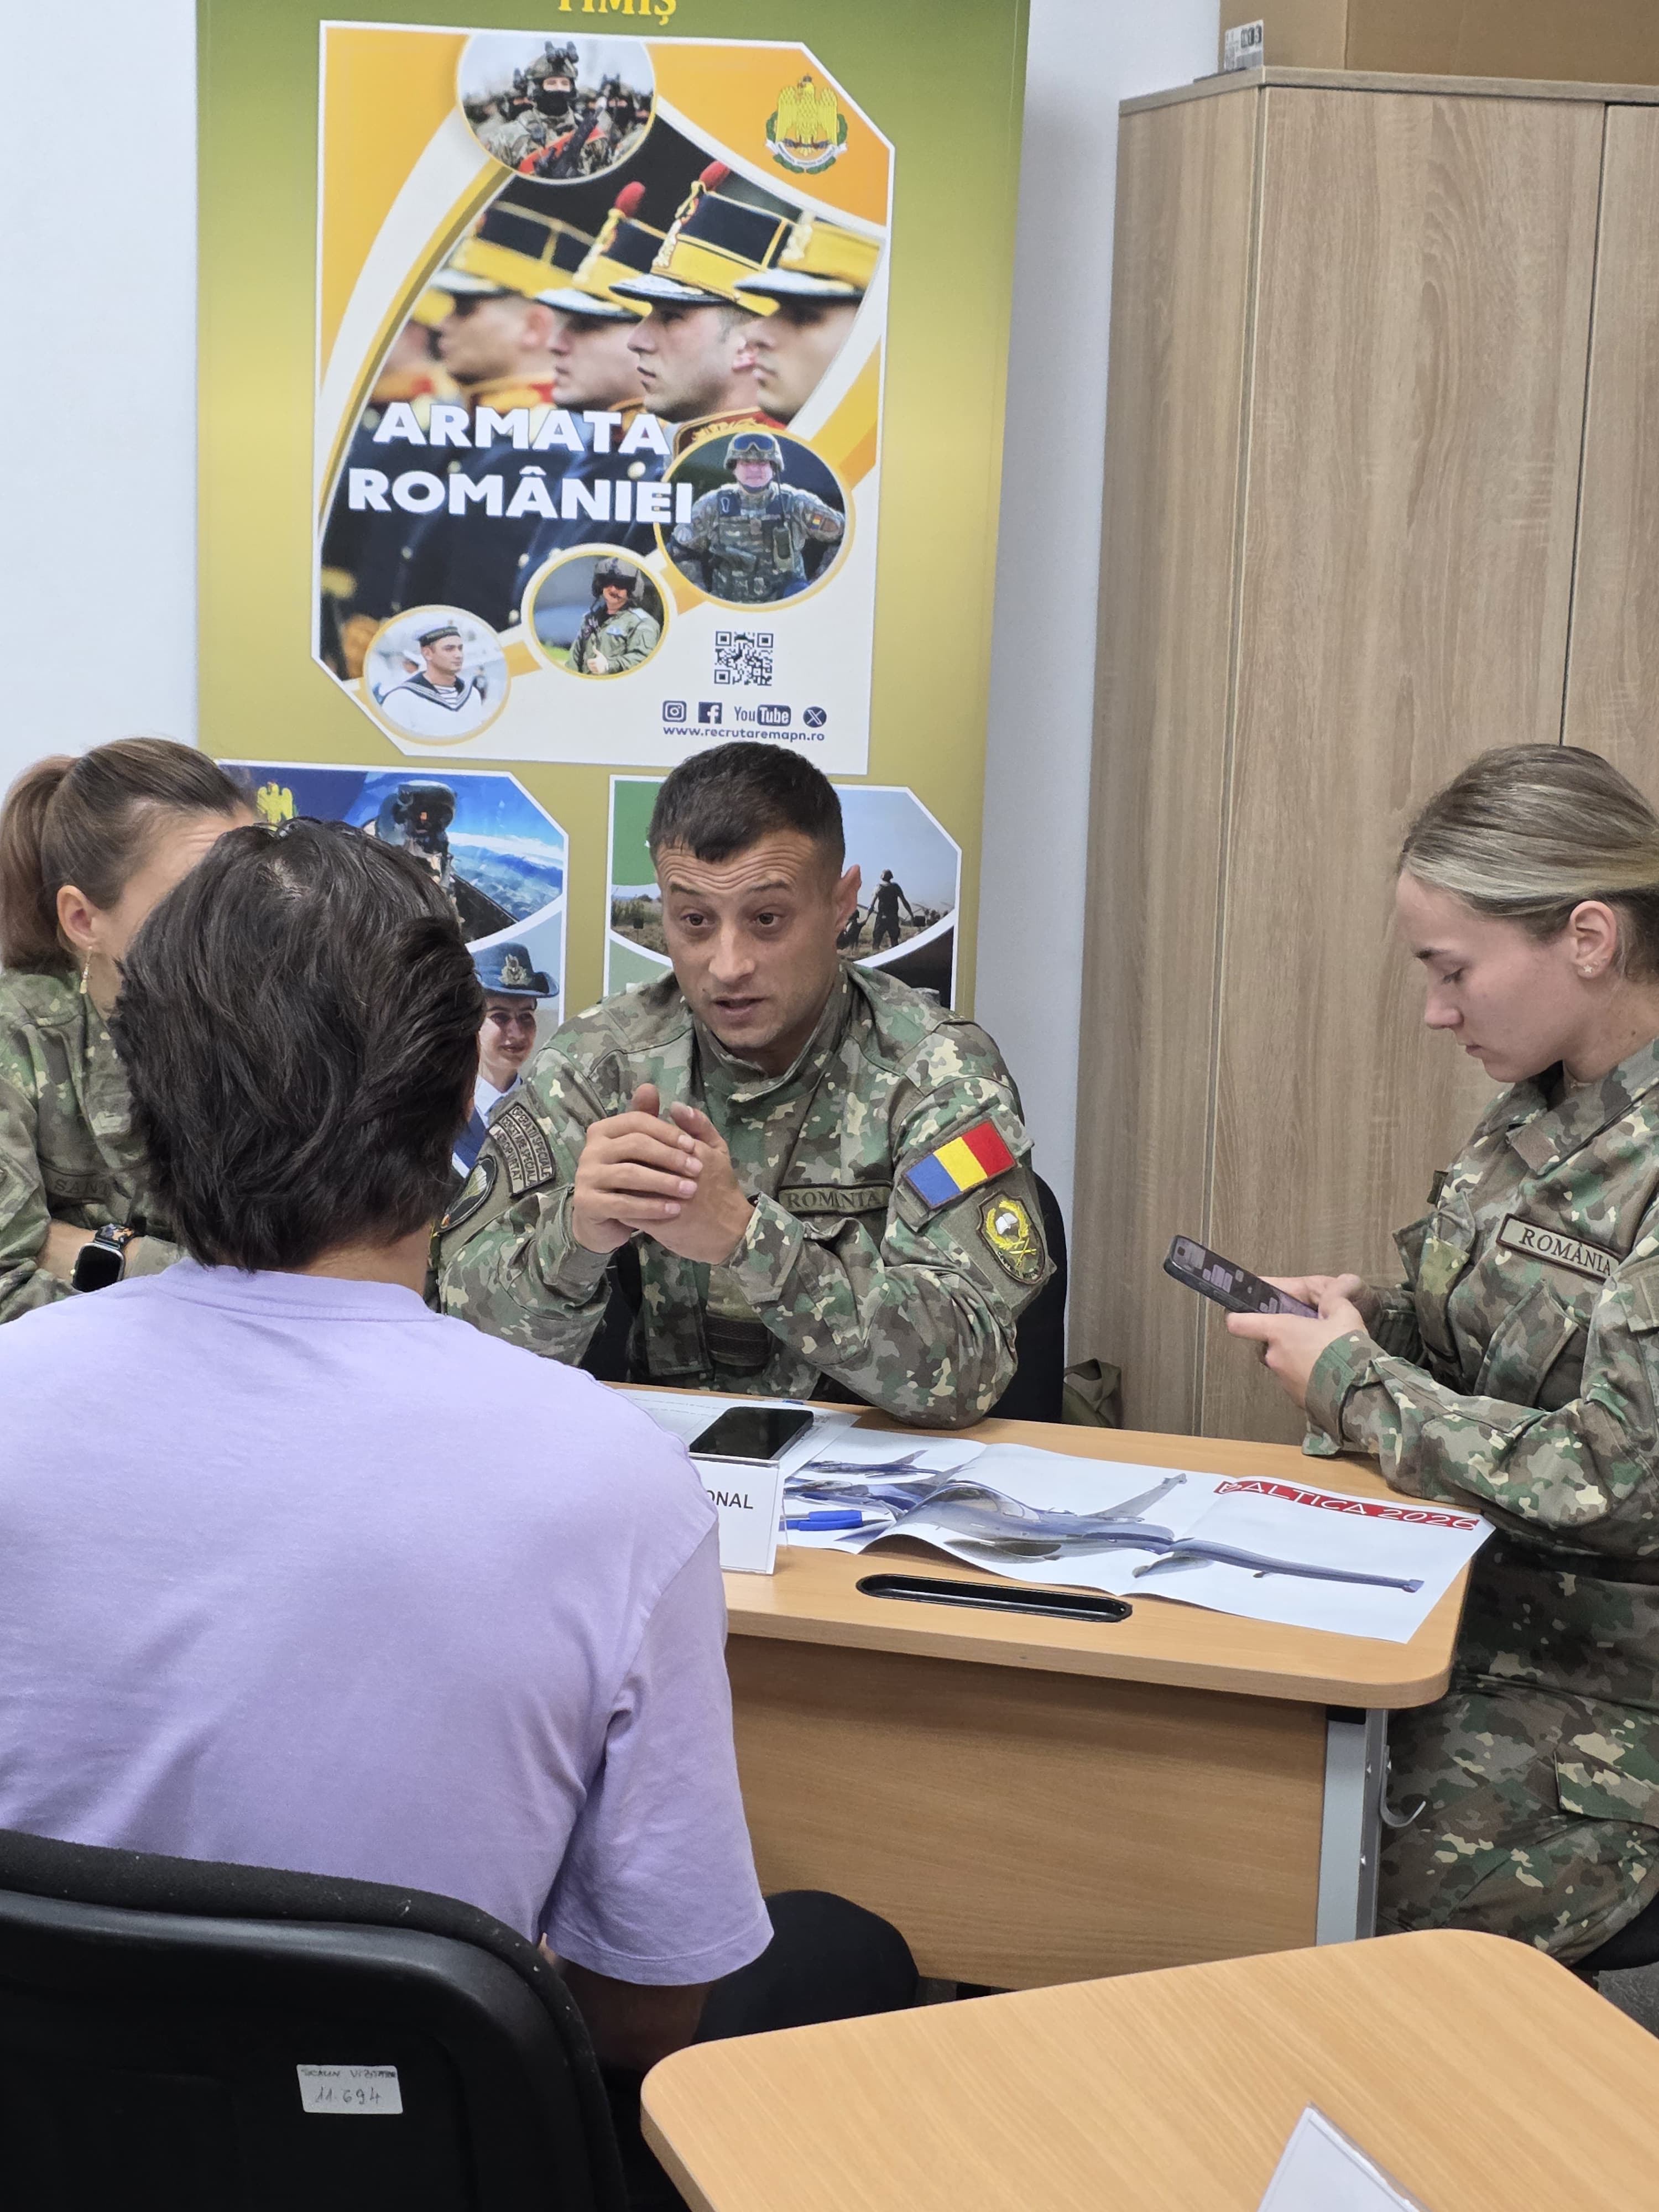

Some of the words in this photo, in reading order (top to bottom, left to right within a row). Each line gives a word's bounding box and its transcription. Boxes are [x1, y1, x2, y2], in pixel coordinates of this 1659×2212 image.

[373, 402, 671, 455] ARMATA
[348, 465, 692, 524] ROMÂNIEI
[663, 726, 825, 742] www.recrutaremapn.ro
[784, 1190, 882, 1209] ROMNIA
[1519, 1227, 1611, 1276] ROMÂNIA
[1378, 1508, 1480, 1531] 2026
